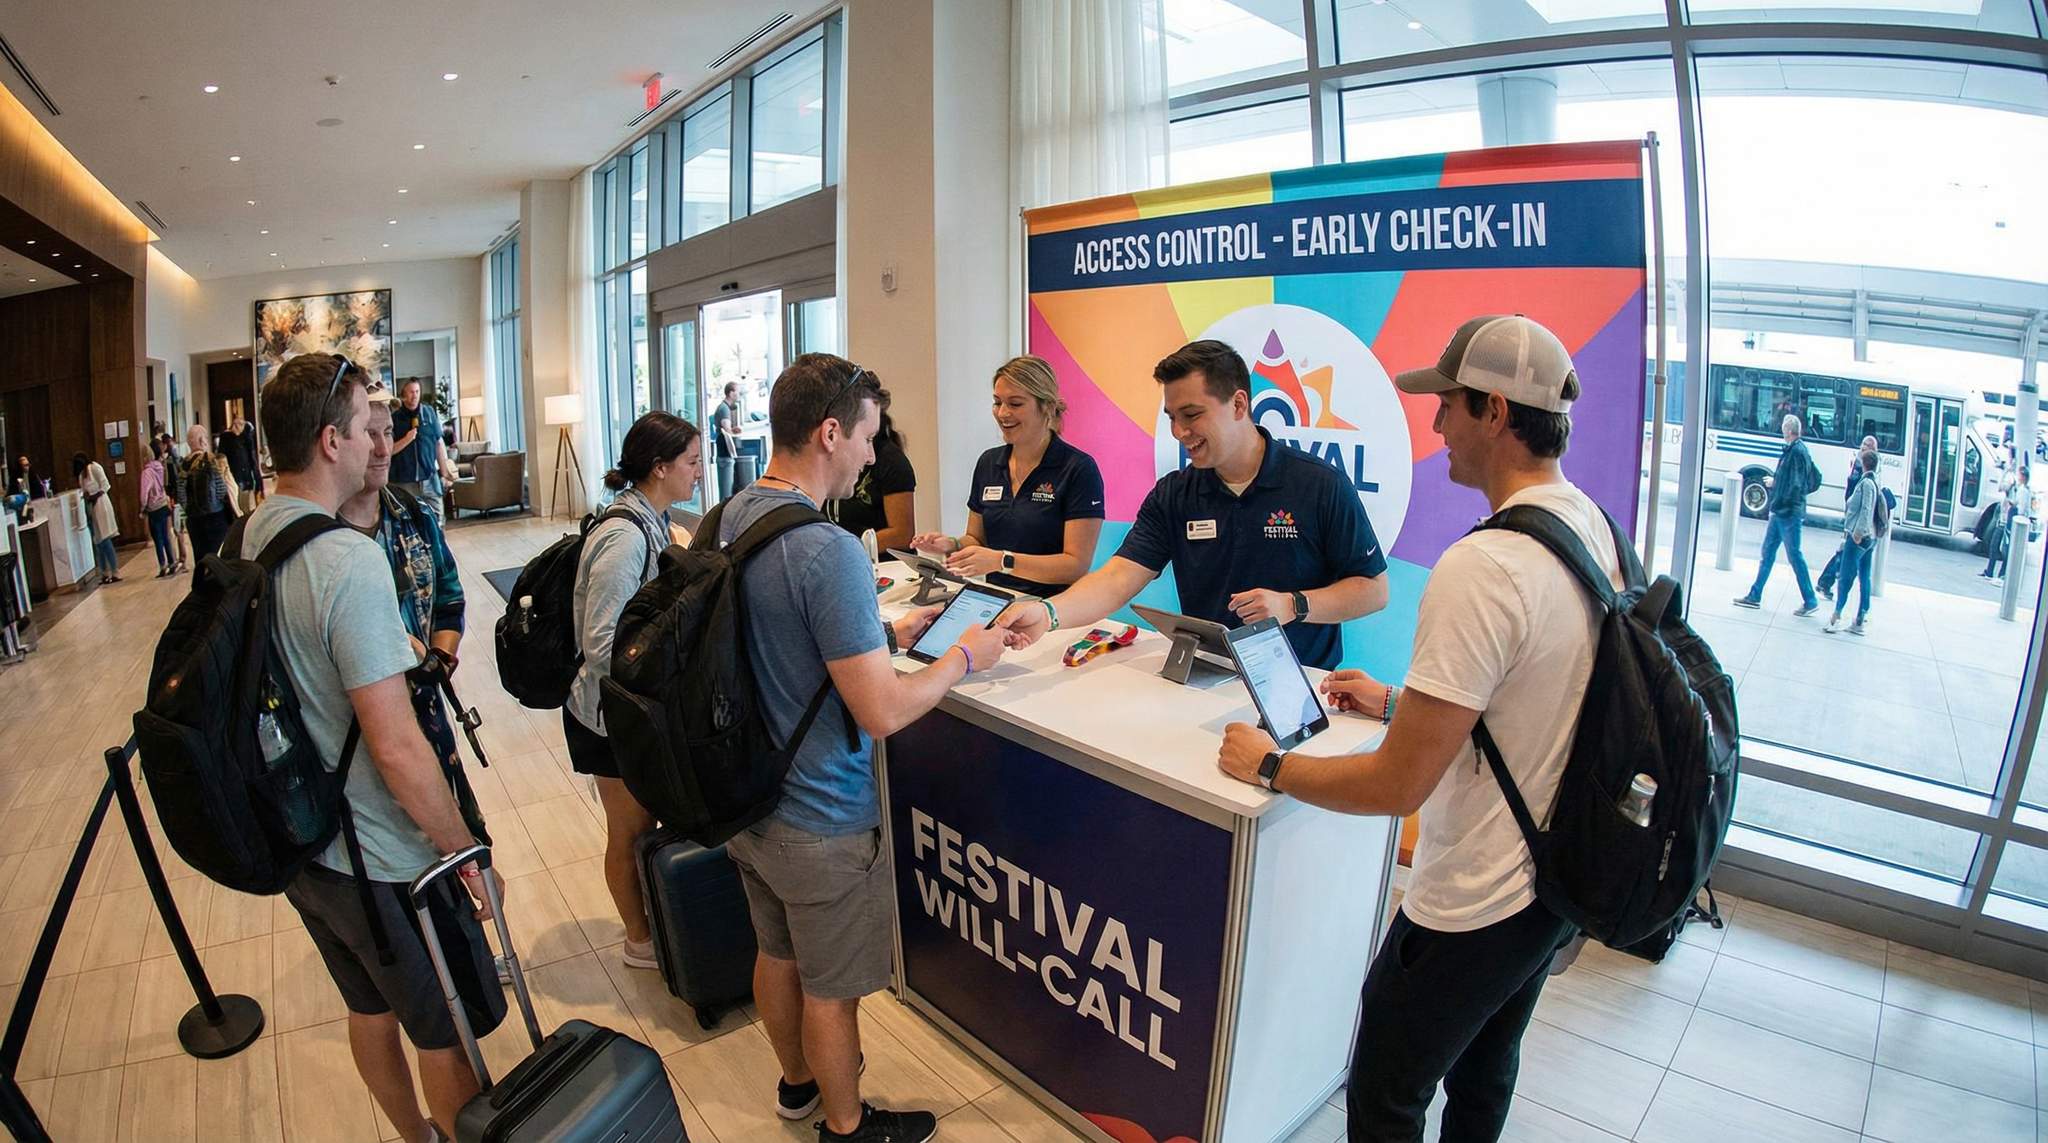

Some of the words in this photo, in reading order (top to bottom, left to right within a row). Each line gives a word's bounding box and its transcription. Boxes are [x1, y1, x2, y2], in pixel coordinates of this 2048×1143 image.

[1073, 234, 1151, 276] ACCESS
[1156, 222, 1266, 268] CONTROL
[1272, 235, 1285, 243] -
[1291, 212, 1382, 257] EARLY
[1390, 202, 1547, 252] CHECK-IN
[911, 806, 1182, 1014] FESTIVAL
[914, 867, 1177, 1072] WILL-CALL
